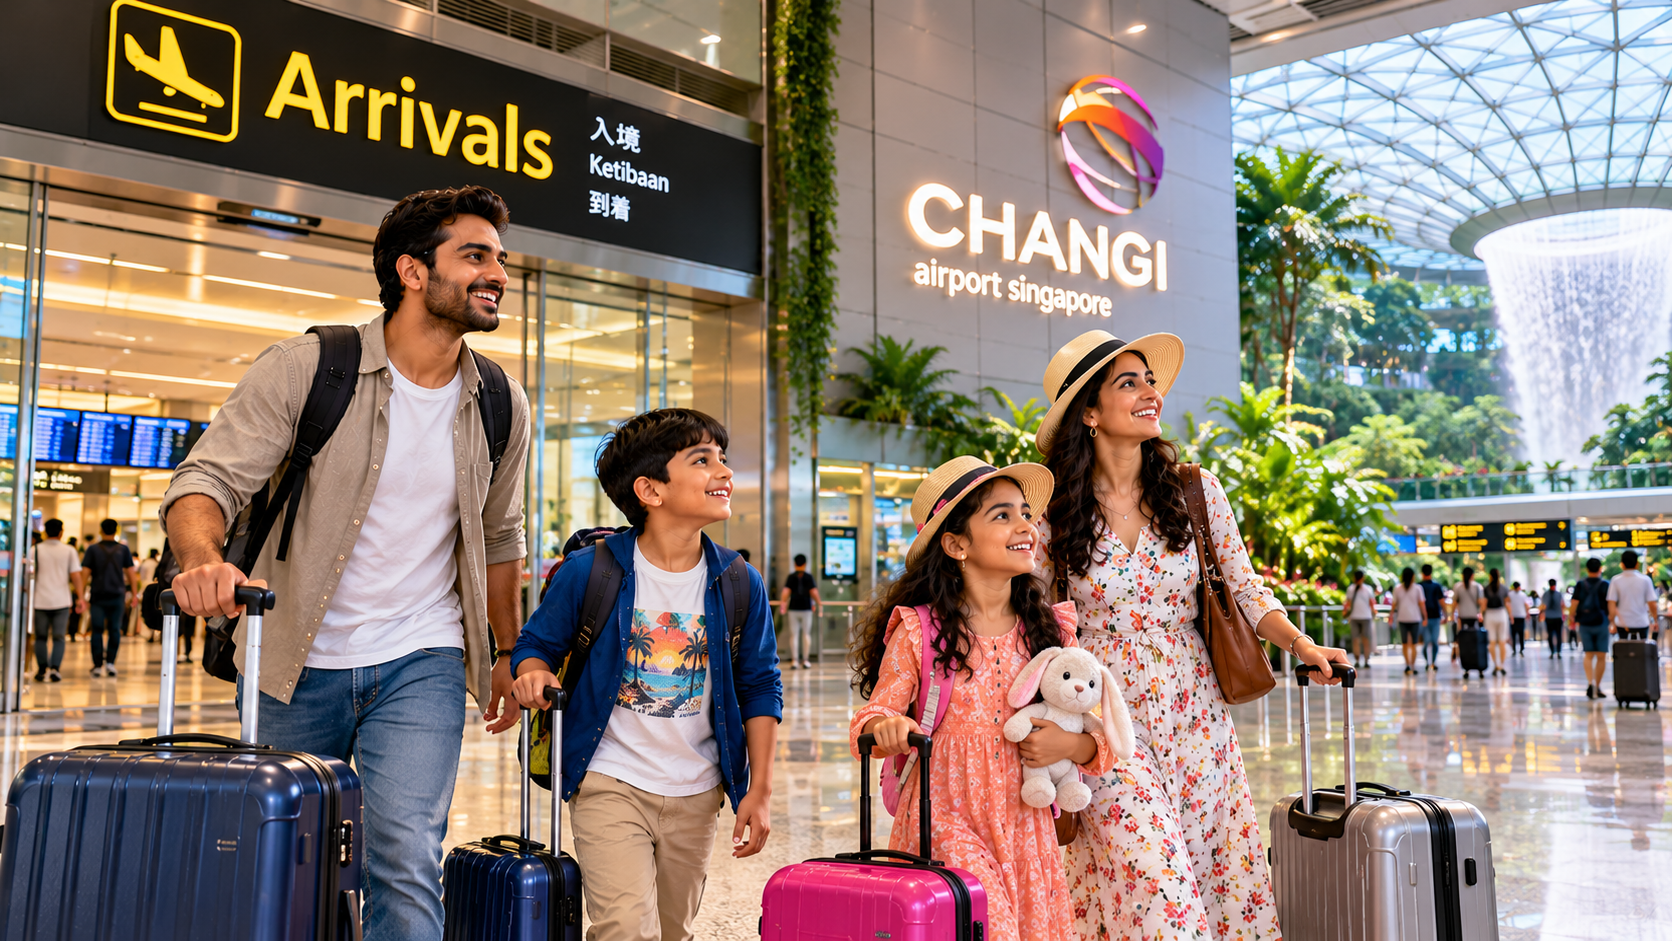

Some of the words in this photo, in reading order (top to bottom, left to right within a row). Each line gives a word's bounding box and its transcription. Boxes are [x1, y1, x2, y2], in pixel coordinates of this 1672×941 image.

[264, 50, 554, 180] Arrivals
[590, 116, 641, 153] 入境
[589, 153, 670, 193] Ketibaan
[589, 190, 630, 222] 到着
[908, 183, 1168, 291] CHANGI
[914, 258, 1002, 298] airport
[1008, 275, 1112, 317] singapore
